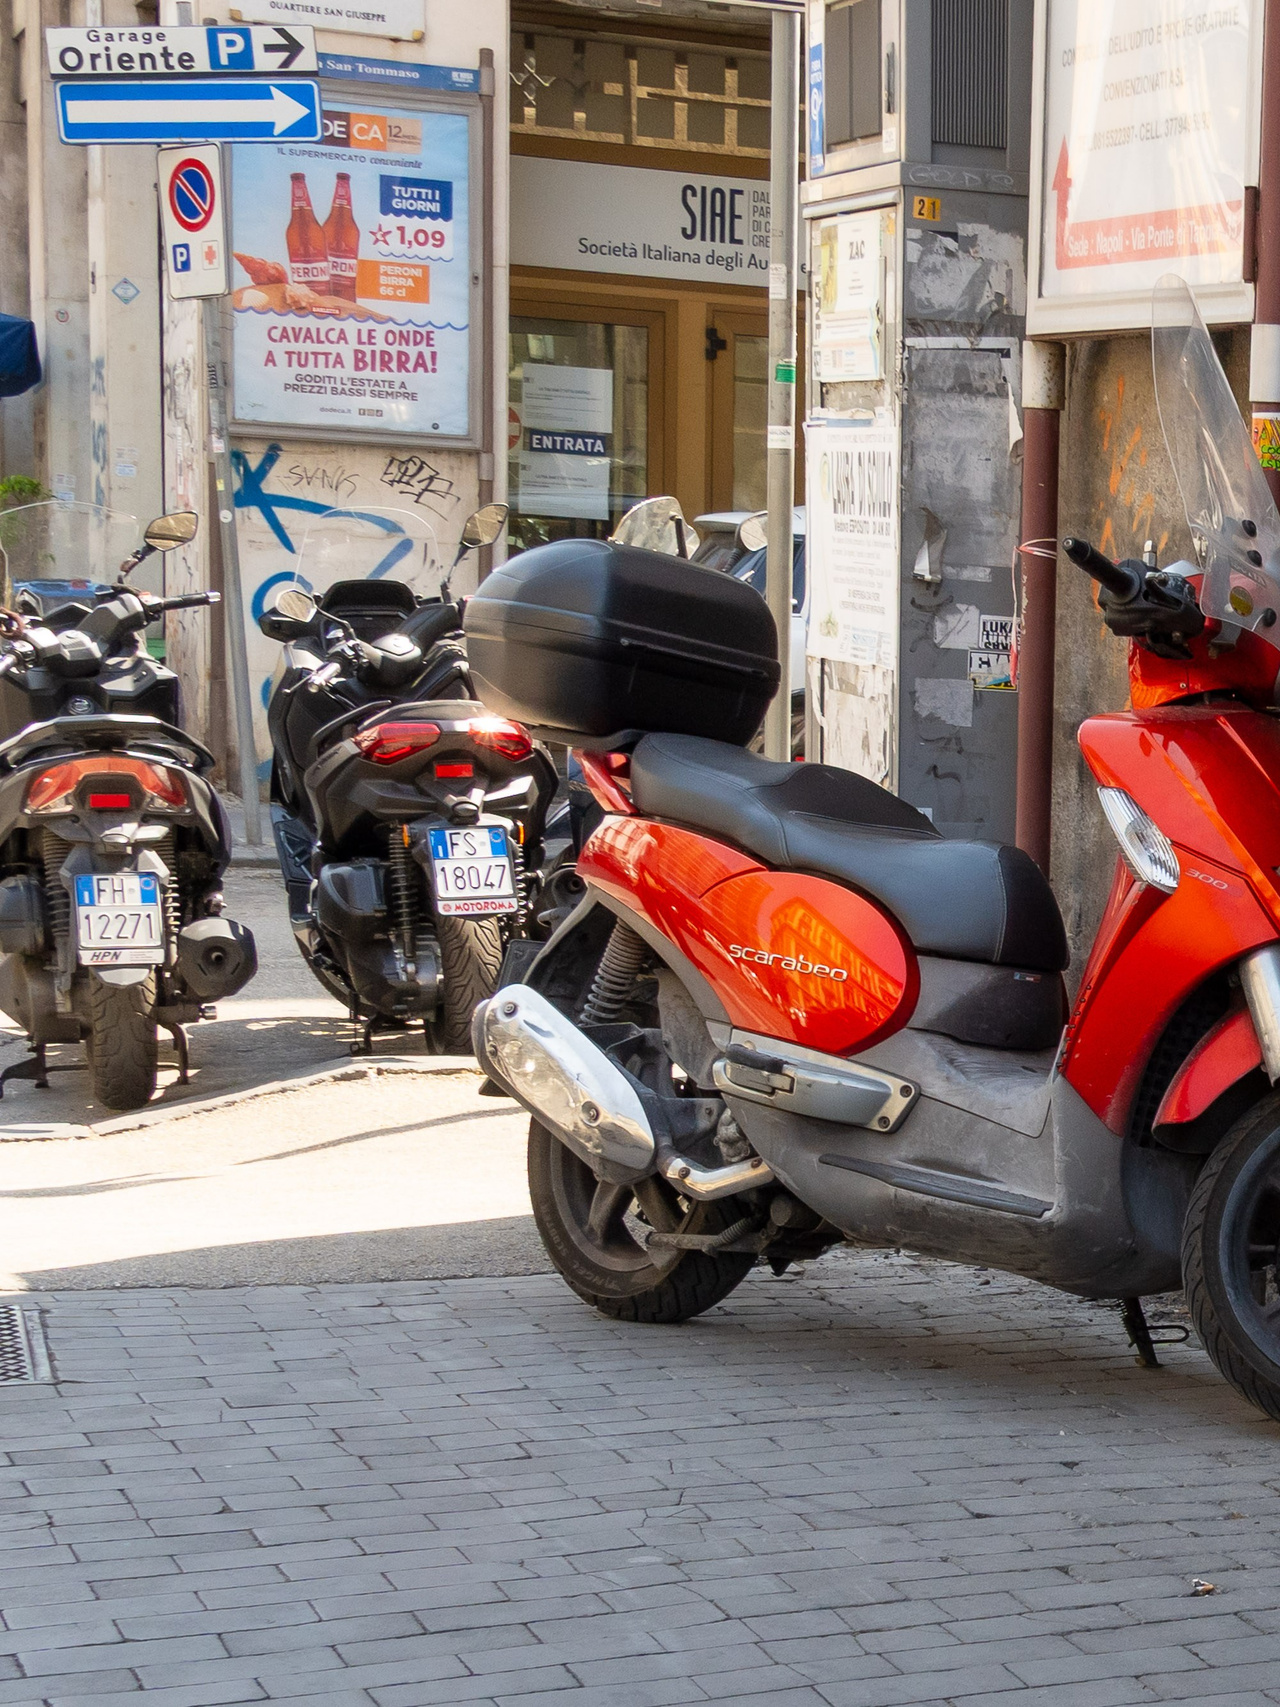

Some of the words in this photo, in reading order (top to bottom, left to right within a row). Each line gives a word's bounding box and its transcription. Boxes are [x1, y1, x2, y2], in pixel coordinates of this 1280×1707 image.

[269, 1, 321, 15] QUARTIERE
[324, 7, 343, 17] SAN
[345, 9, 386, 22] GIUSEPPE
[86, 29, 166, 44] Garage
[59, 46, 196, 72] Oriente
[217, 33, 245, 66] P
[327, 60, 353, 71] San
[356, 63, 420, 79] Tommaso
[353, 123, 384, 142] CA
[388, 125, 402, 138] 12
[277, 147, 286, 156] IL
[288, 148, 366, 163] SUPERMERCATO
[370, 157, 423, 169] conveniente
[392, 186, 432, 200] TUTTI
[752, 190, 771, 204] DAL
[392, 200, 440, 213] GIORNI
[681, 184, 745, 246] SIAE
[752, 205, 771, 218] PAR
[918, 198, 936, 219] 21
[752, 220, 762, 233] DI
[396, 226, 446, 249] 1,09
[752, 234, 771, 248] CRE
[1067, 236, 1088, 258] Sede
[1096, 229, 1124, 258] Napoli
[1131, 227, 1146, 250] Via
[1147, 225, 1174, 248] Ponte
[175, 247, 187, 269] P
[578, 238, 637, 258] Società
[642, 243, 701, 265] Italiana
[705, 249, 743, 272] degli
[747, 253, 768, 270] Au
[379, 264, 423, 277] PERONI
[379, 275, 415, 288] BIRRA
[379, 286, 394, 296] 66
[395, 287, 406, 297] cl
[267, 325, 349, 345] CAVALCA
[357, 328, 377, 345] LE
[384, 329, 435, 347] ONDE
[264, 350, 277, 368] A
[284, 351, 345, 369] TUTTA
[353, 348, 438, 374] BIRRA!
[284, 382, 327, 395] PREZZI
[331, 386, 367, 398] BASSI
[370, 390, 419, 401] SEMPRE
[295, 373, 337, 385] GODITI
[340, 376, 396, 390] L'ESTATE
[398, 380, 408, 390] A
[319, 406, 353, 414] dodeca.it
[531, 434, 604, 453] ENTRATA
[449, 832, 477, 856] FS
[441, 865, 506, 891] 18047
[1185, 868, 1228, 890] 300
[96, 877, 125, 903] FH
[454, 901, 515, 912] MOTOROMA
[85, 913, 153, 940] 12271
[90, 951, 122, 961] HPN
[728, 944, 848, 982] scarabeo
